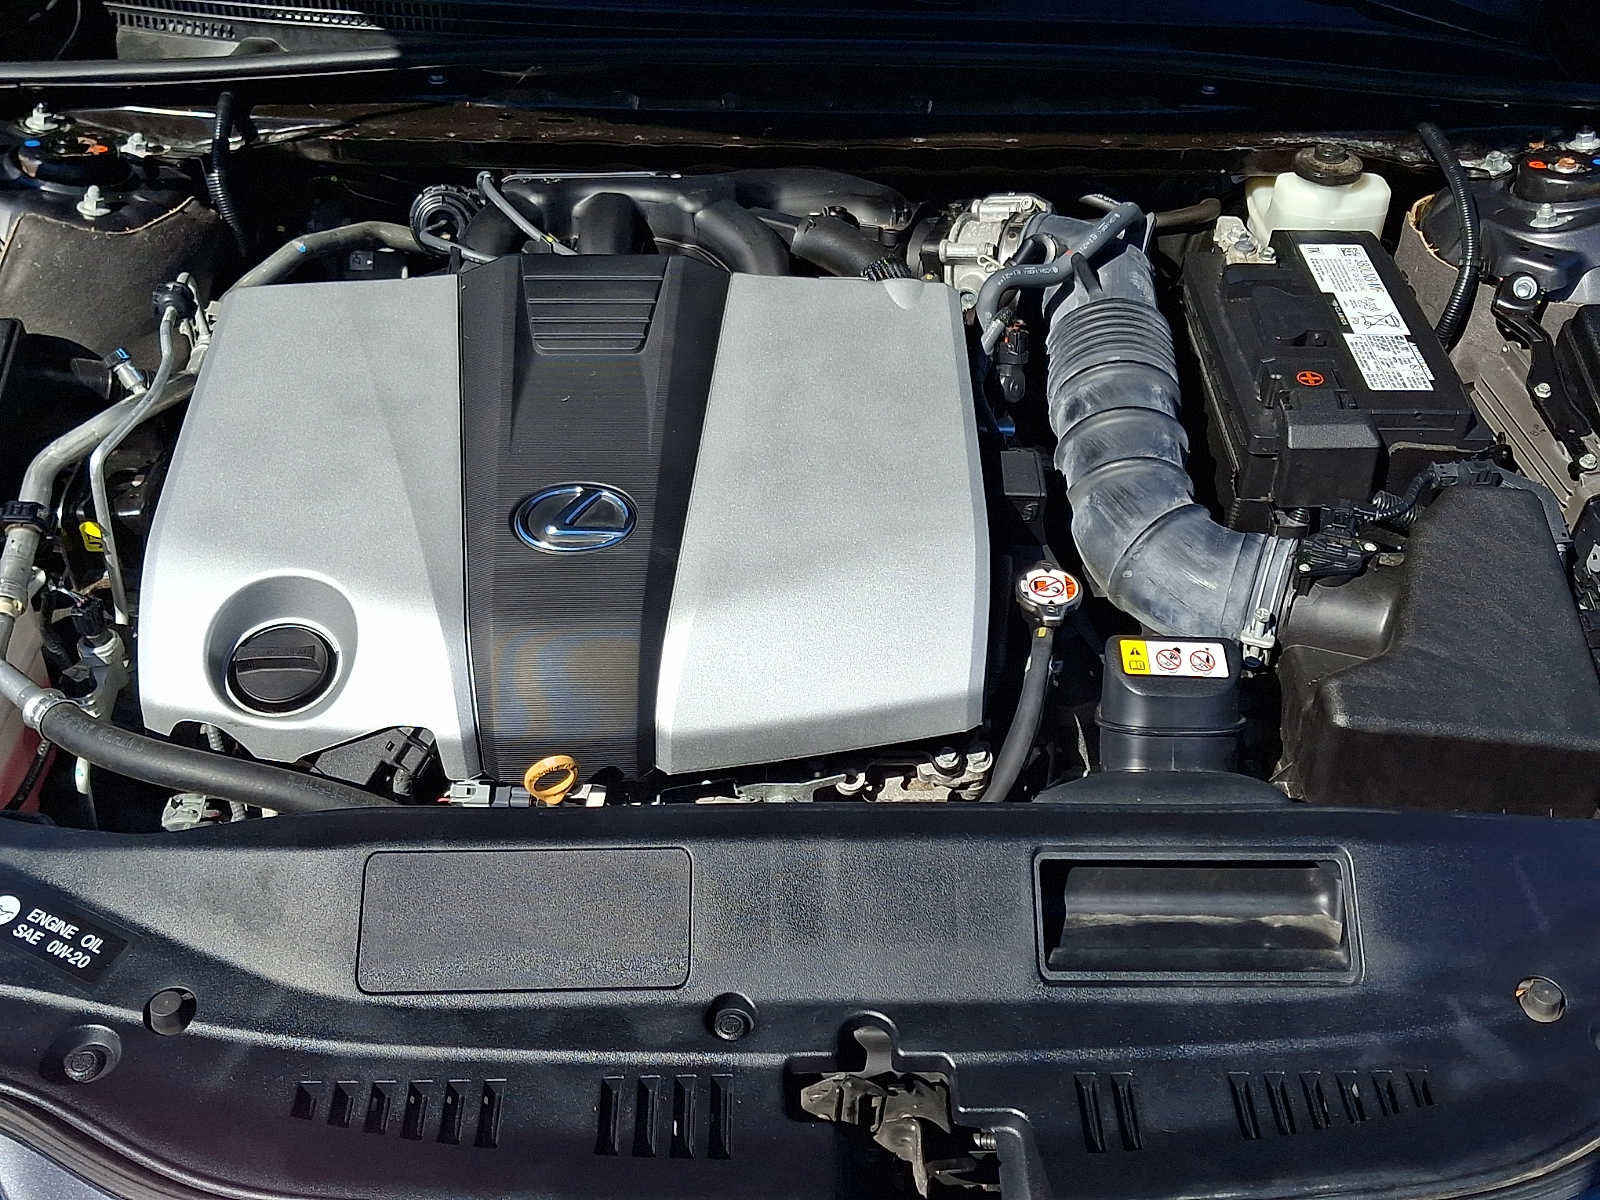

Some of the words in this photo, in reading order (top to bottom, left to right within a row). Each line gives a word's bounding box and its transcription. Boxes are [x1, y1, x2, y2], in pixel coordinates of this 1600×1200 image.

[12, 924, 45, 946] SAE
[46, 940, 91, 969] 0W-20
[26, 908, 80, 940] ENGINE
[80, 934, 104, 955] OIL
